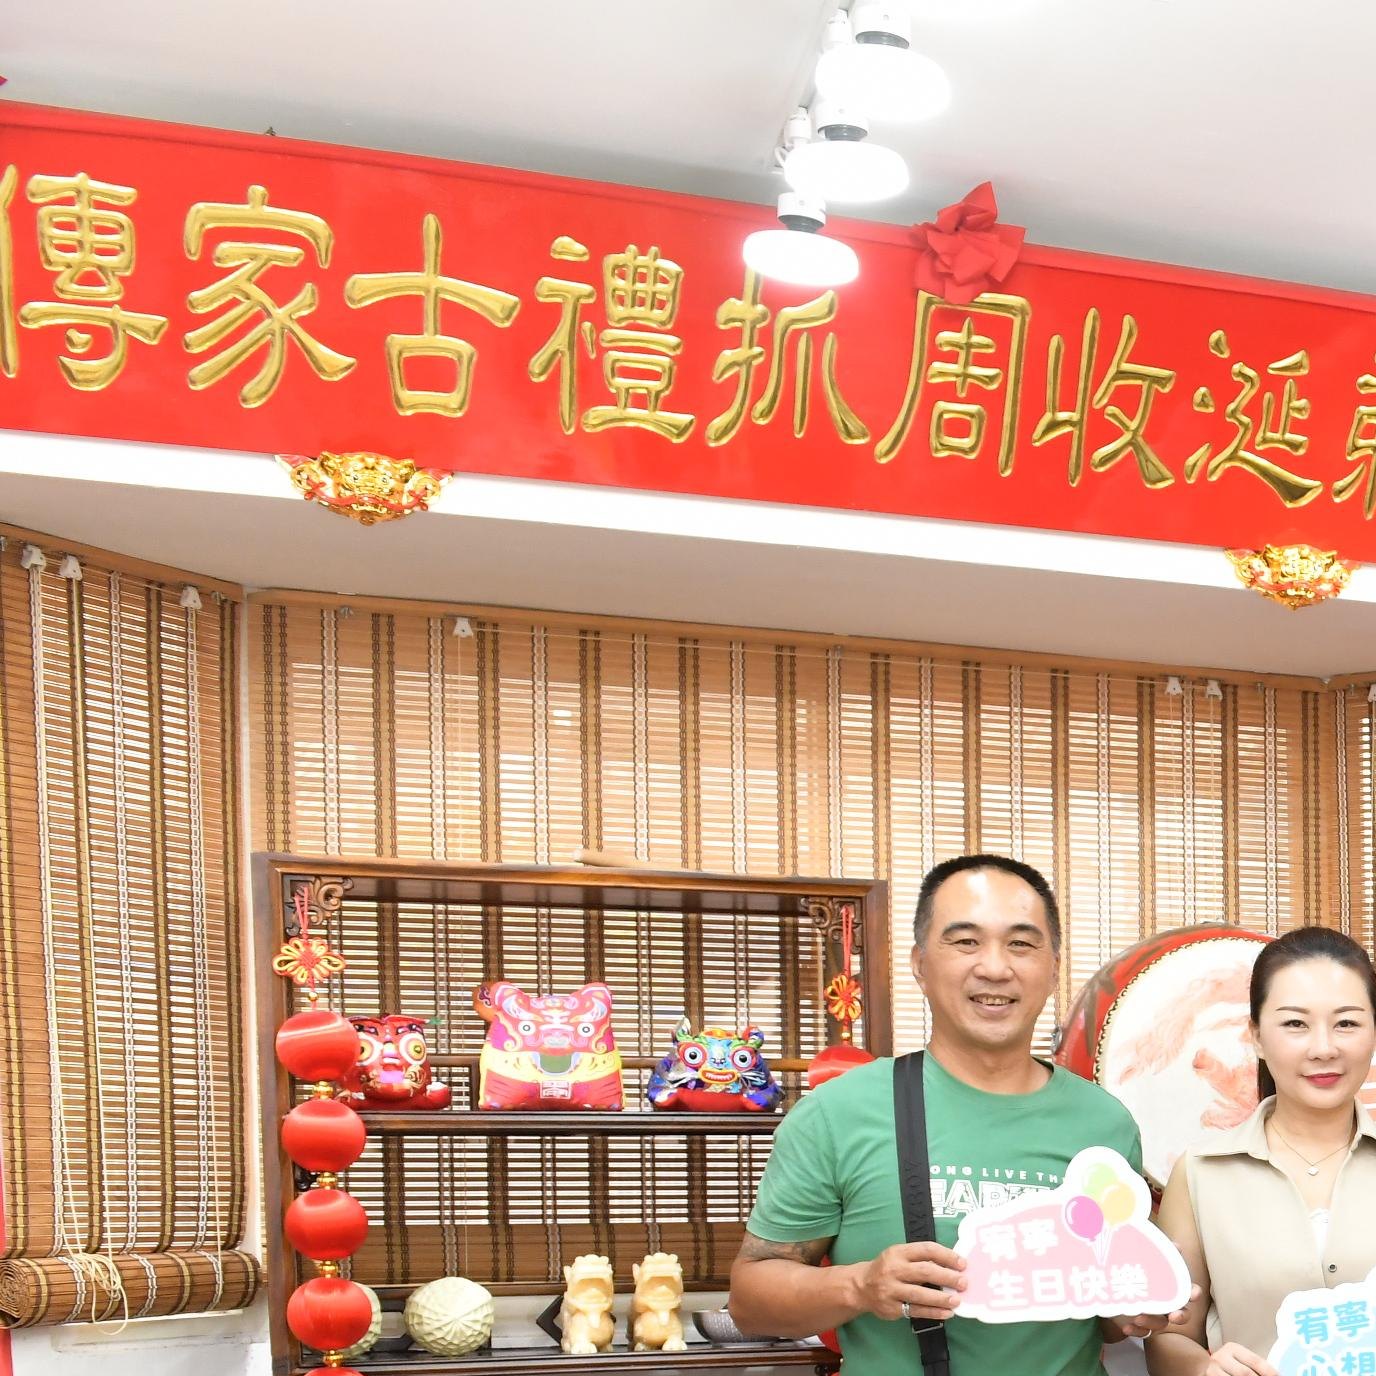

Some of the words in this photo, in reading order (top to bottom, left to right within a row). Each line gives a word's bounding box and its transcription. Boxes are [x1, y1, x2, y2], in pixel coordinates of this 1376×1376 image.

[930, 1165, 973, 1176] ONG
[982, 1167, 1028, 1180] LIVE
[1036, 1172, 1065, 1184] TH
[988, 1264, 1149, 1308] 生日快樂
[1294, 1299, 1369, 1346] 宥寧
